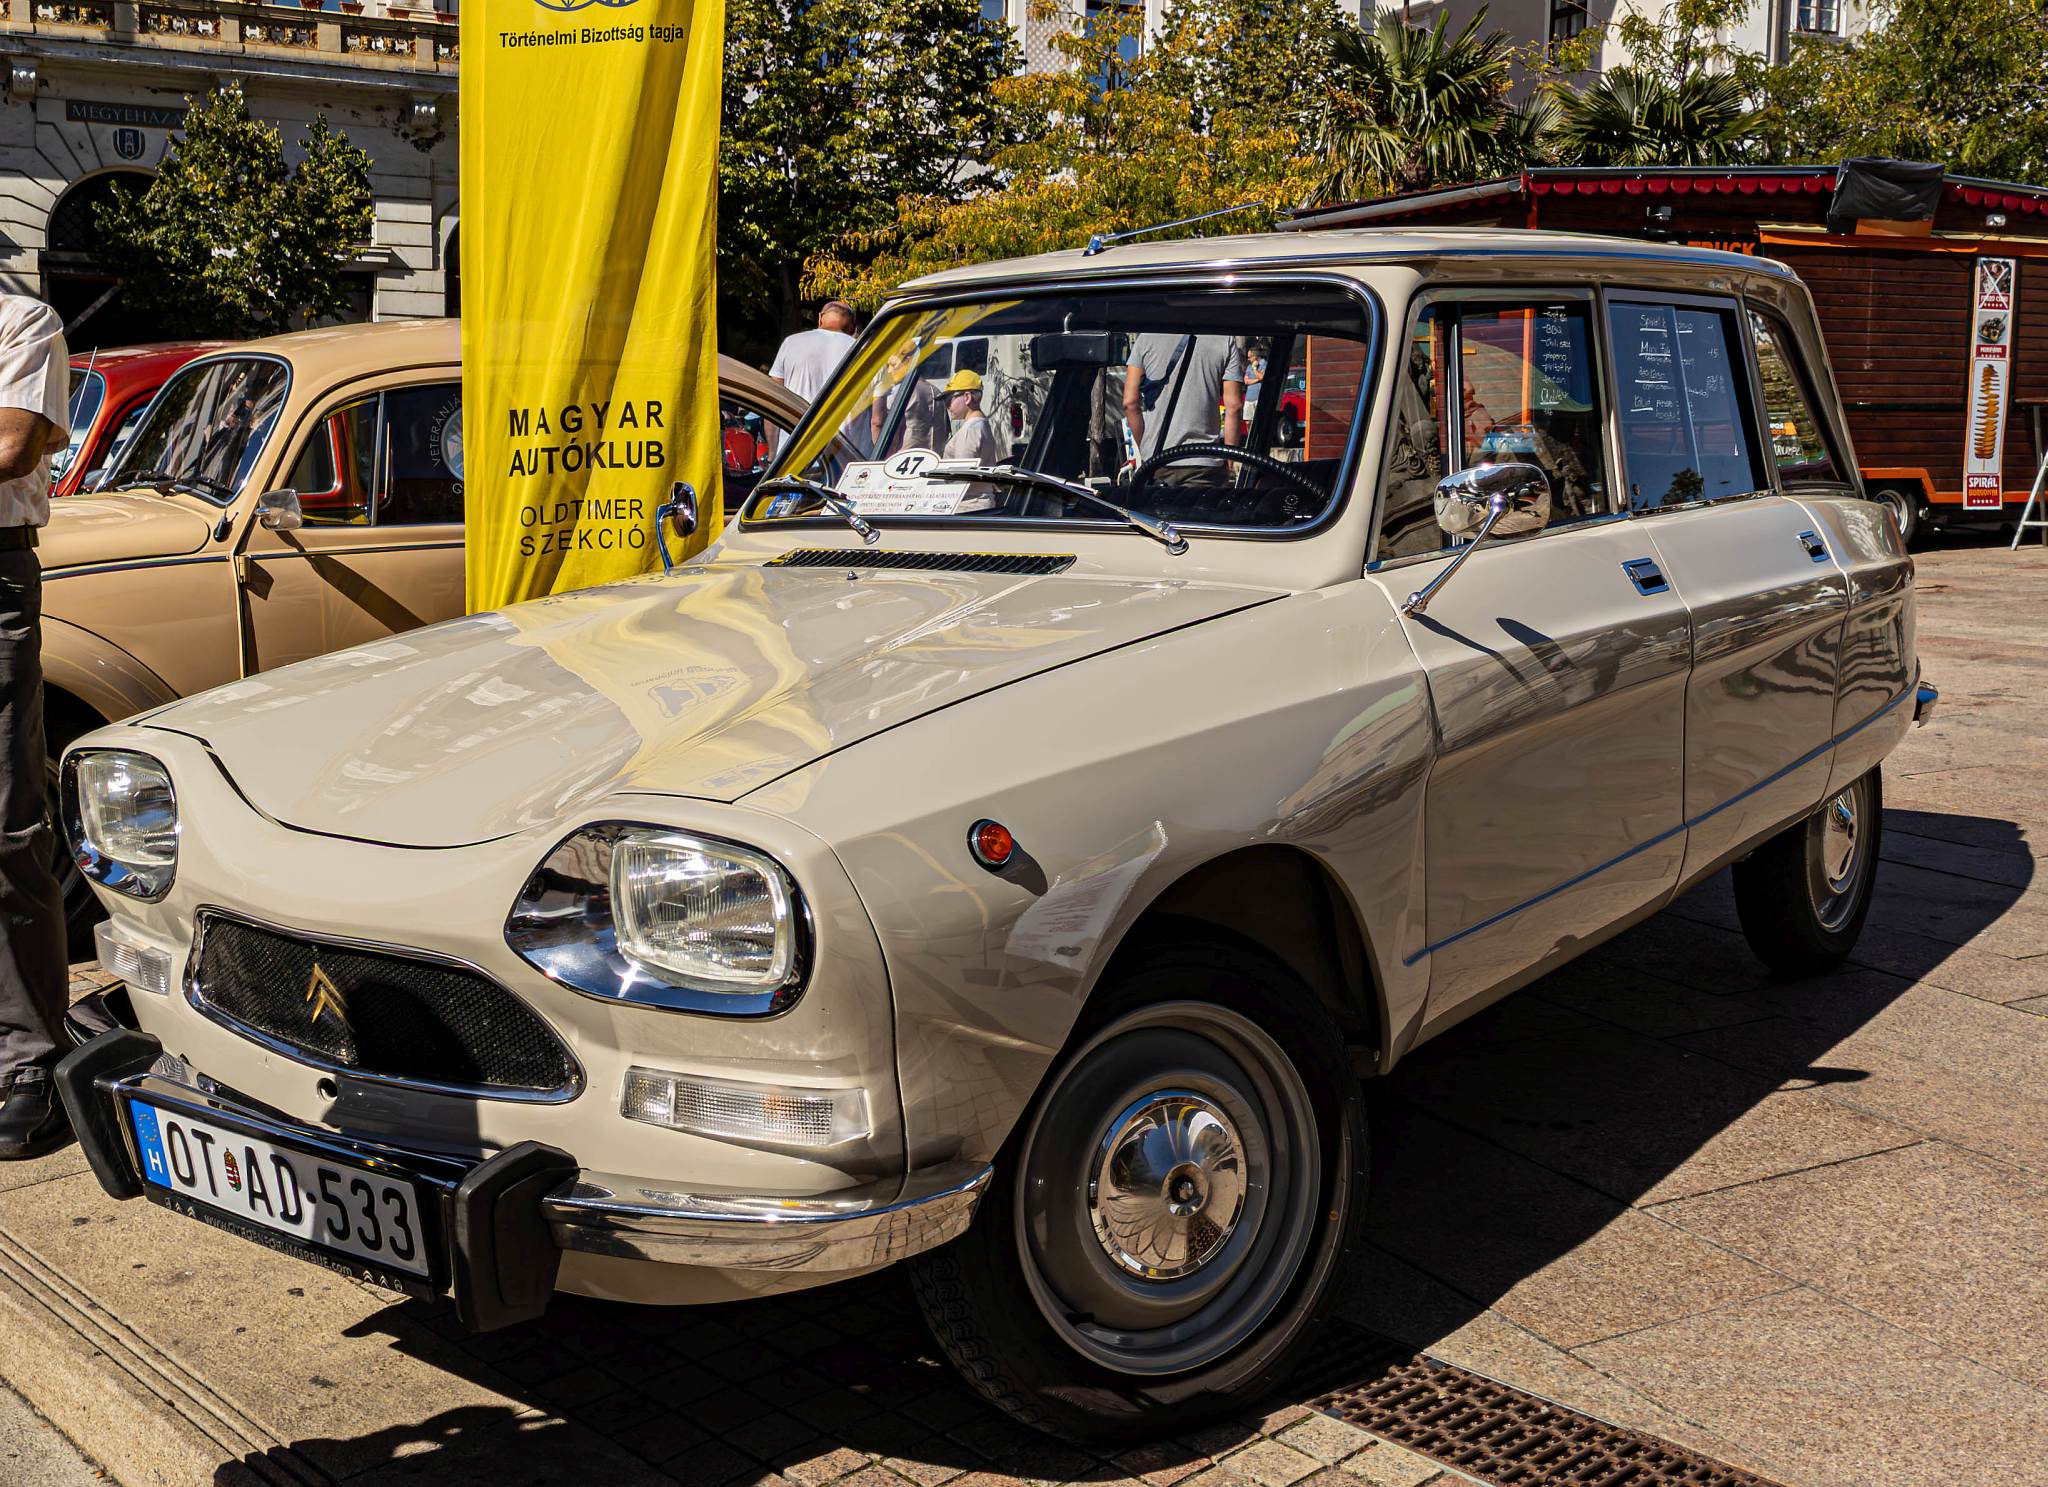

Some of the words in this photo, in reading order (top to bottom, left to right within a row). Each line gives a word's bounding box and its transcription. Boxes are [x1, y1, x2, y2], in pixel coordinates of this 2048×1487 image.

[499, 29, 577, 48] Történelmi
[581, 24, 644, 44] Bizottság
[649, 23, 684, 42] tagja
[508, 401, 664, 437] MAGYAR
[508, 437, 665, 477] AUTÓKLUB
[895, 456, 925, 475] 47
[520, 499, 645, 528] OLDTIMER
[520, 524, 646, 557] SZEKCIÓ
[147, 1148, 163, 1175] H
[166, 1120, 219, 1198] OT
